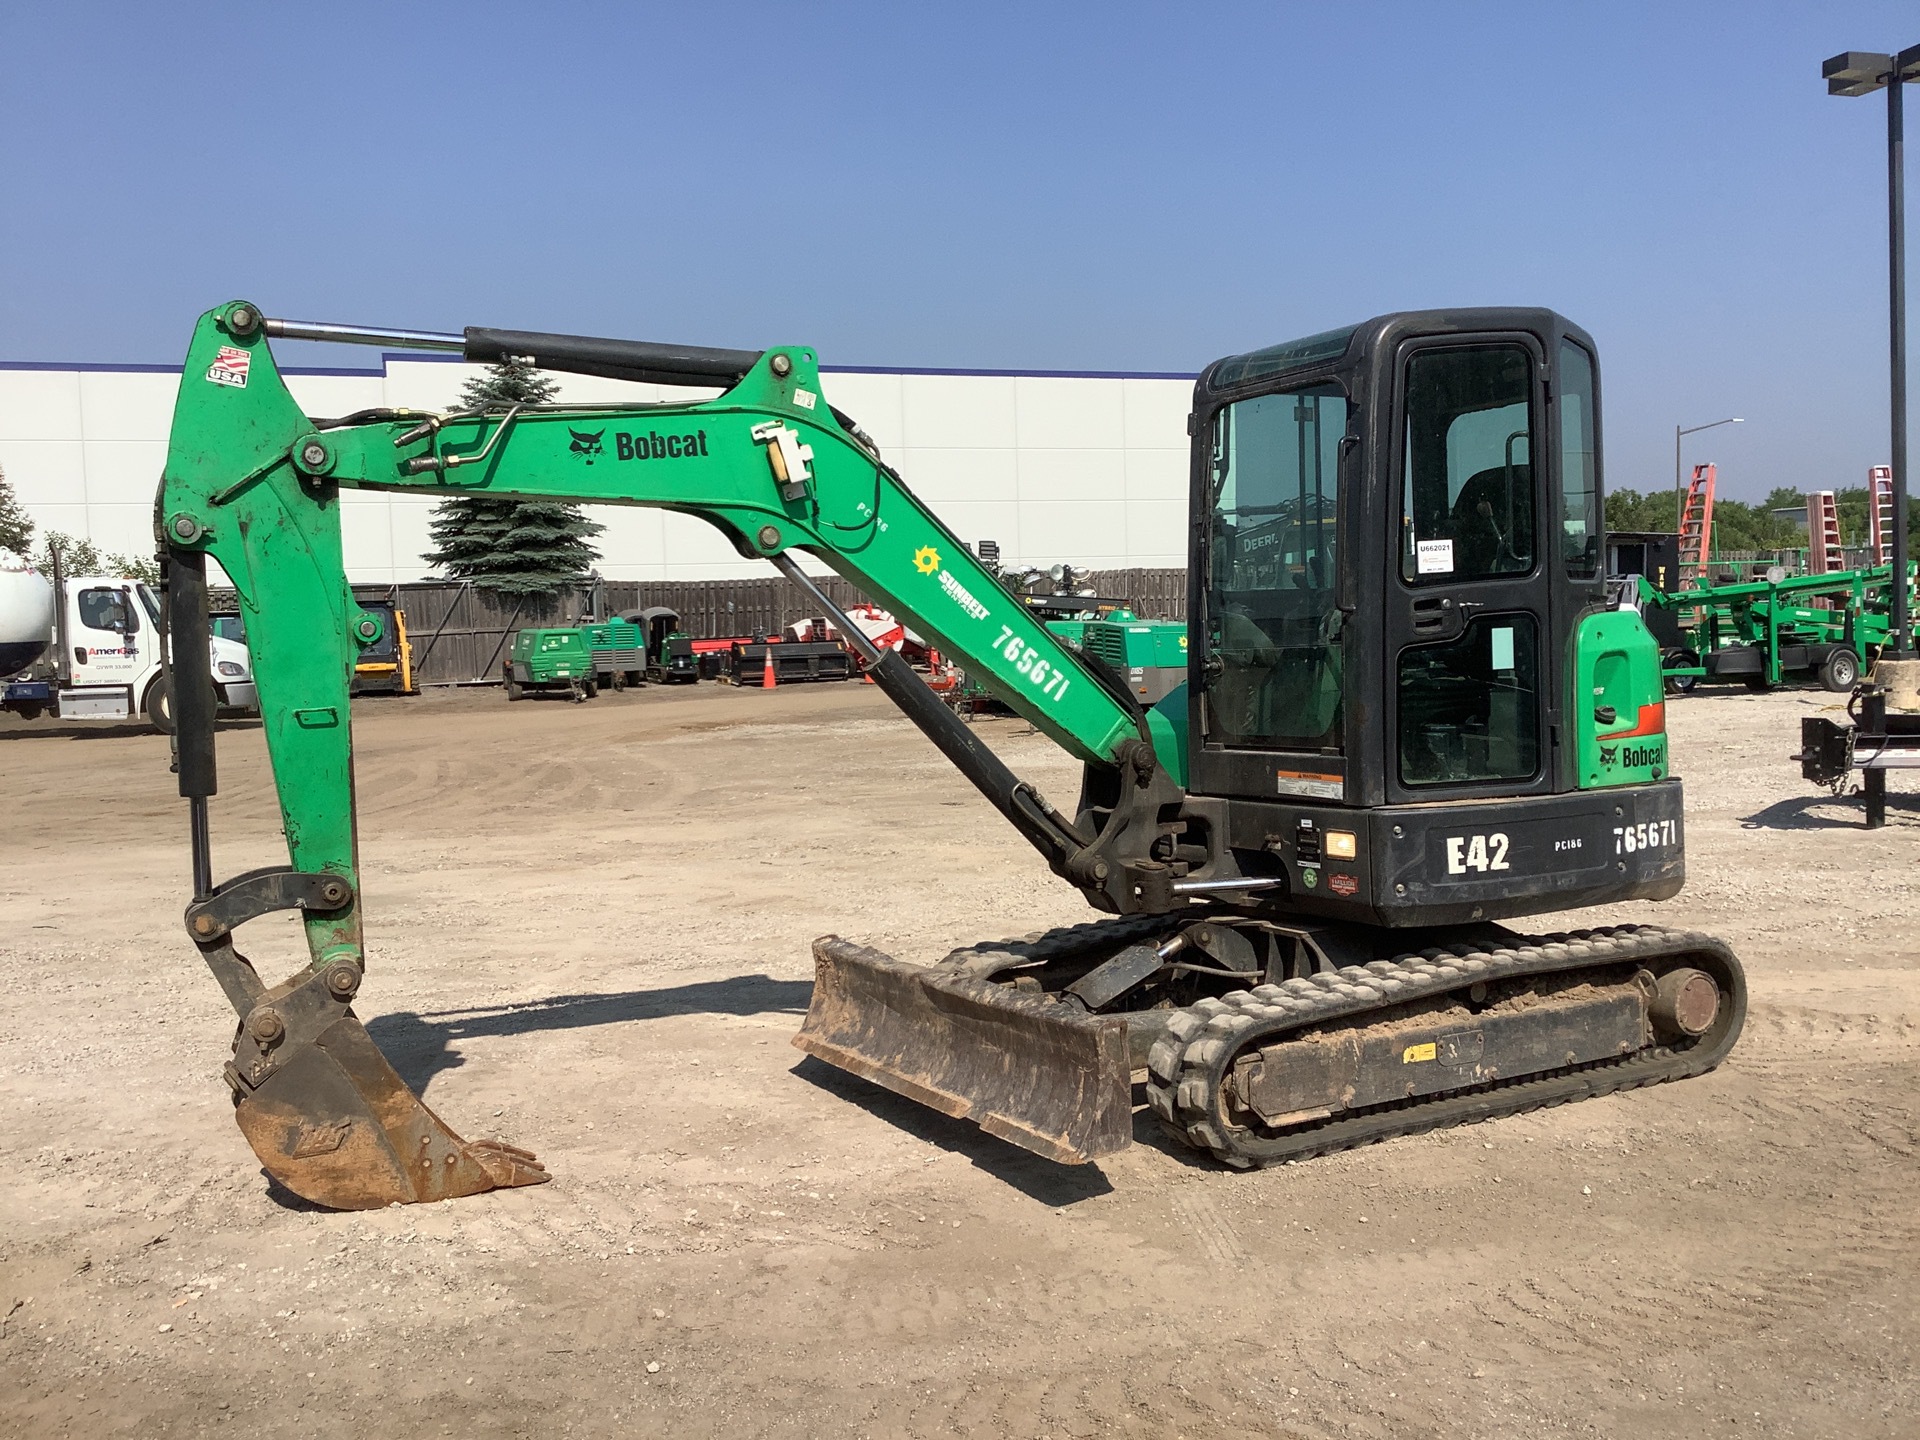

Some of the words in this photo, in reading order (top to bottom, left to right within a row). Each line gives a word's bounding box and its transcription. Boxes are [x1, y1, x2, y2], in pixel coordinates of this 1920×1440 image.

[209, 369, 244, 384] USA
[615, 429, 709, 461] Bobcat
[1420, 544, 1450, 552] U662021
[938, 569, 991, 620] SUNBELT
[941, 584, 977, 620] RENTALS
[88, 647, 140, 656] AmeriGas
[991, 624, 1071, 702] 765671
[1622, 743, 1664, 769] Bobcat
[1446, 832, 1510, 875] E42
[1613, 819, 1676, 855] 765671
